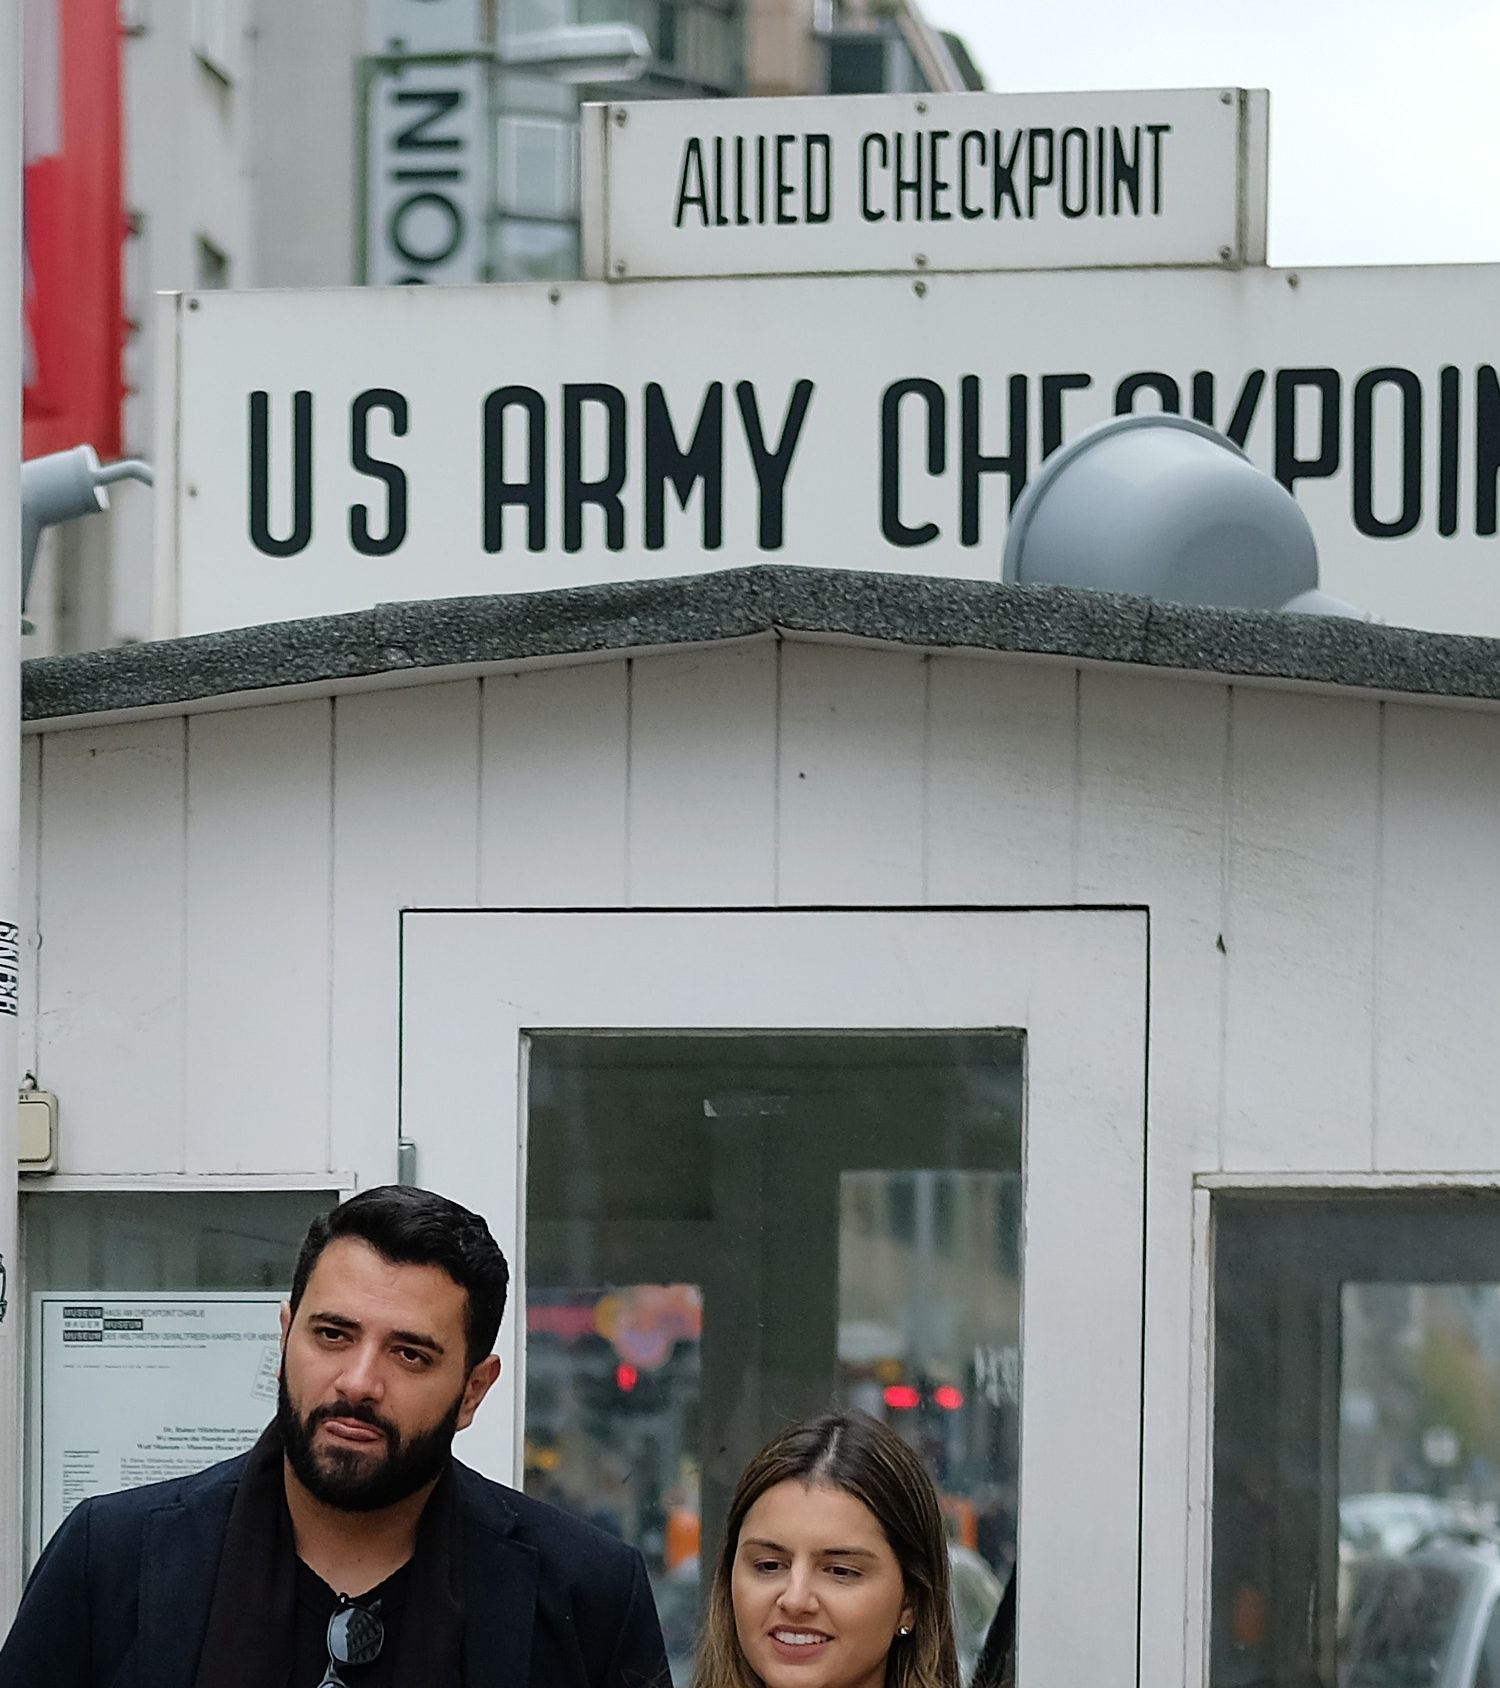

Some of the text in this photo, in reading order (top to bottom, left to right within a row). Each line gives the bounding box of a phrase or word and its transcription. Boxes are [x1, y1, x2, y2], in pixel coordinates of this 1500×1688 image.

[674, 122, 1172, 229] ALLIED CHECKPOINT
[248, 388, 410, 558] US
[480, 378, 815, 555] ARMY
